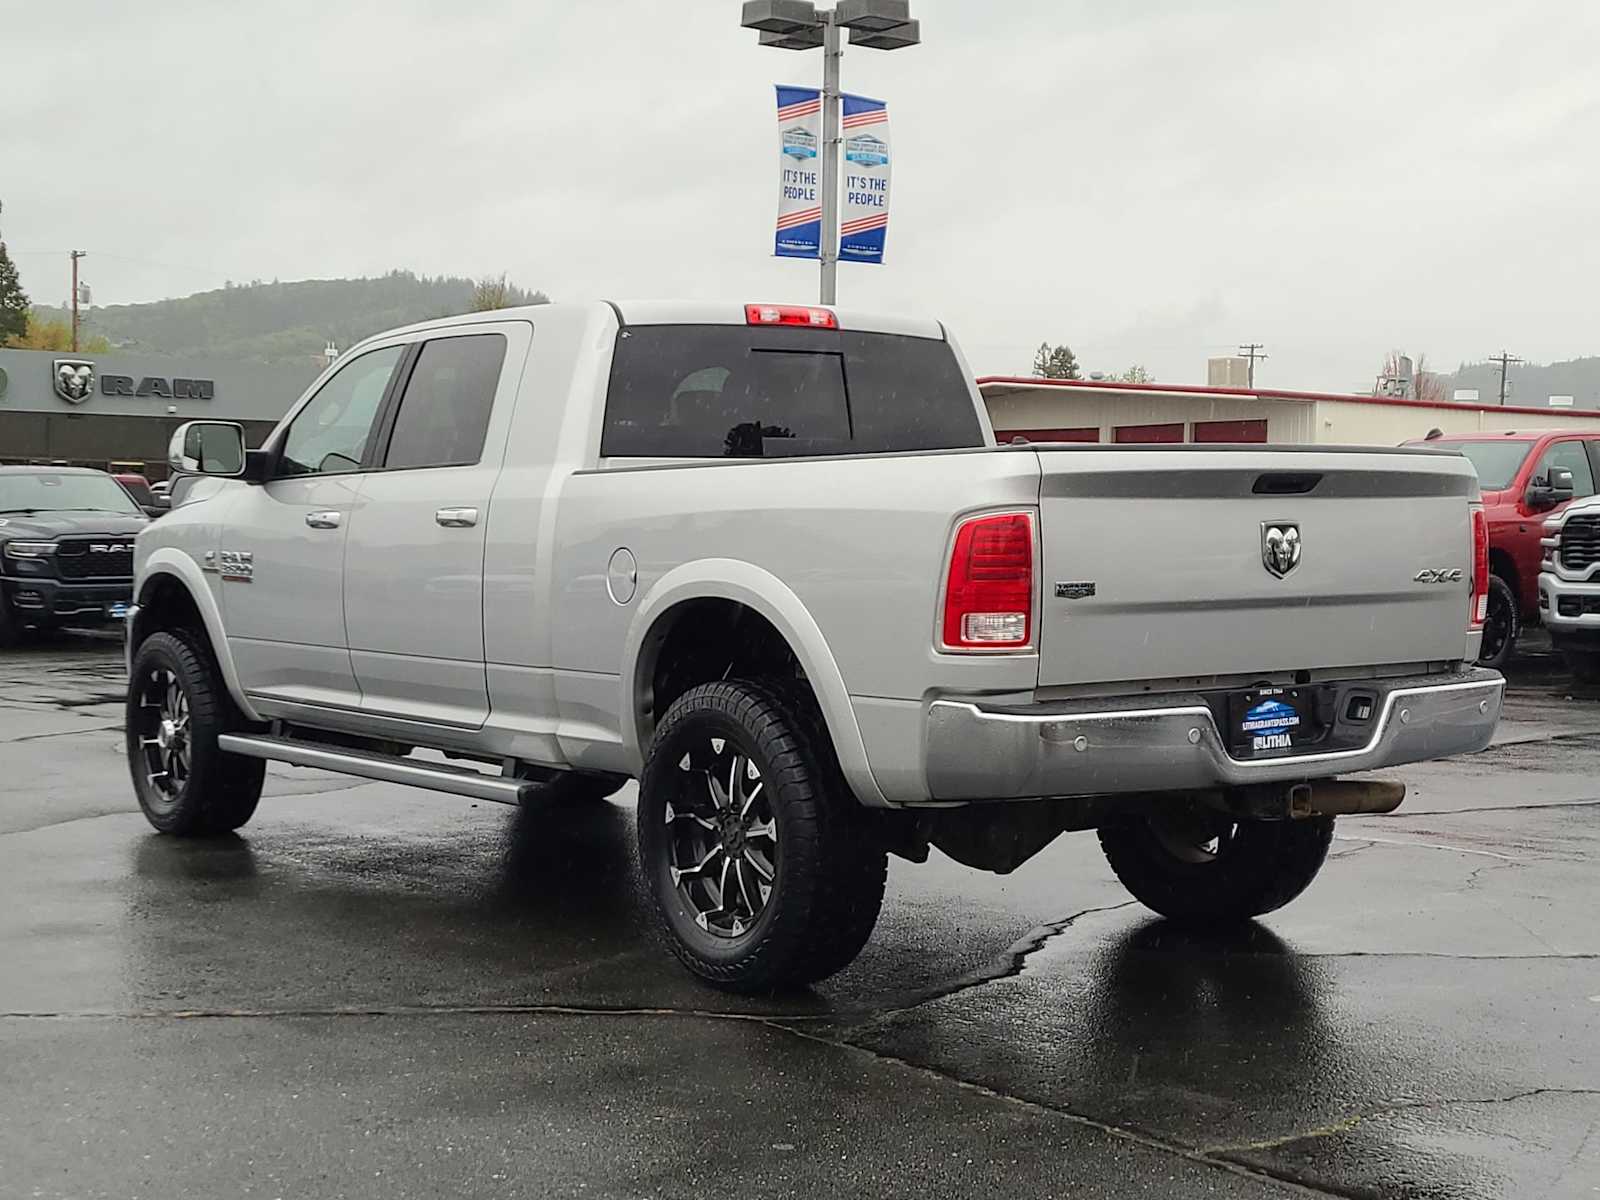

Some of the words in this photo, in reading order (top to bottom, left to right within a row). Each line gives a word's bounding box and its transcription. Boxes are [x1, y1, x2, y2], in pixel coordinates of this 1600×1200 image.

[783, 169, 798, 184] IT'S
[799, 171, 817, 185] THE
[847, 176, 867, 189] IT'S
[869, 178, 887, 191] THE
[783, 186, 816, 201] PEOPLE
[848, 192, 885, 207] PEOPLE
[101, 374, 214, 400] RAM
[1262, 734, 1292, 748] LITHIA
